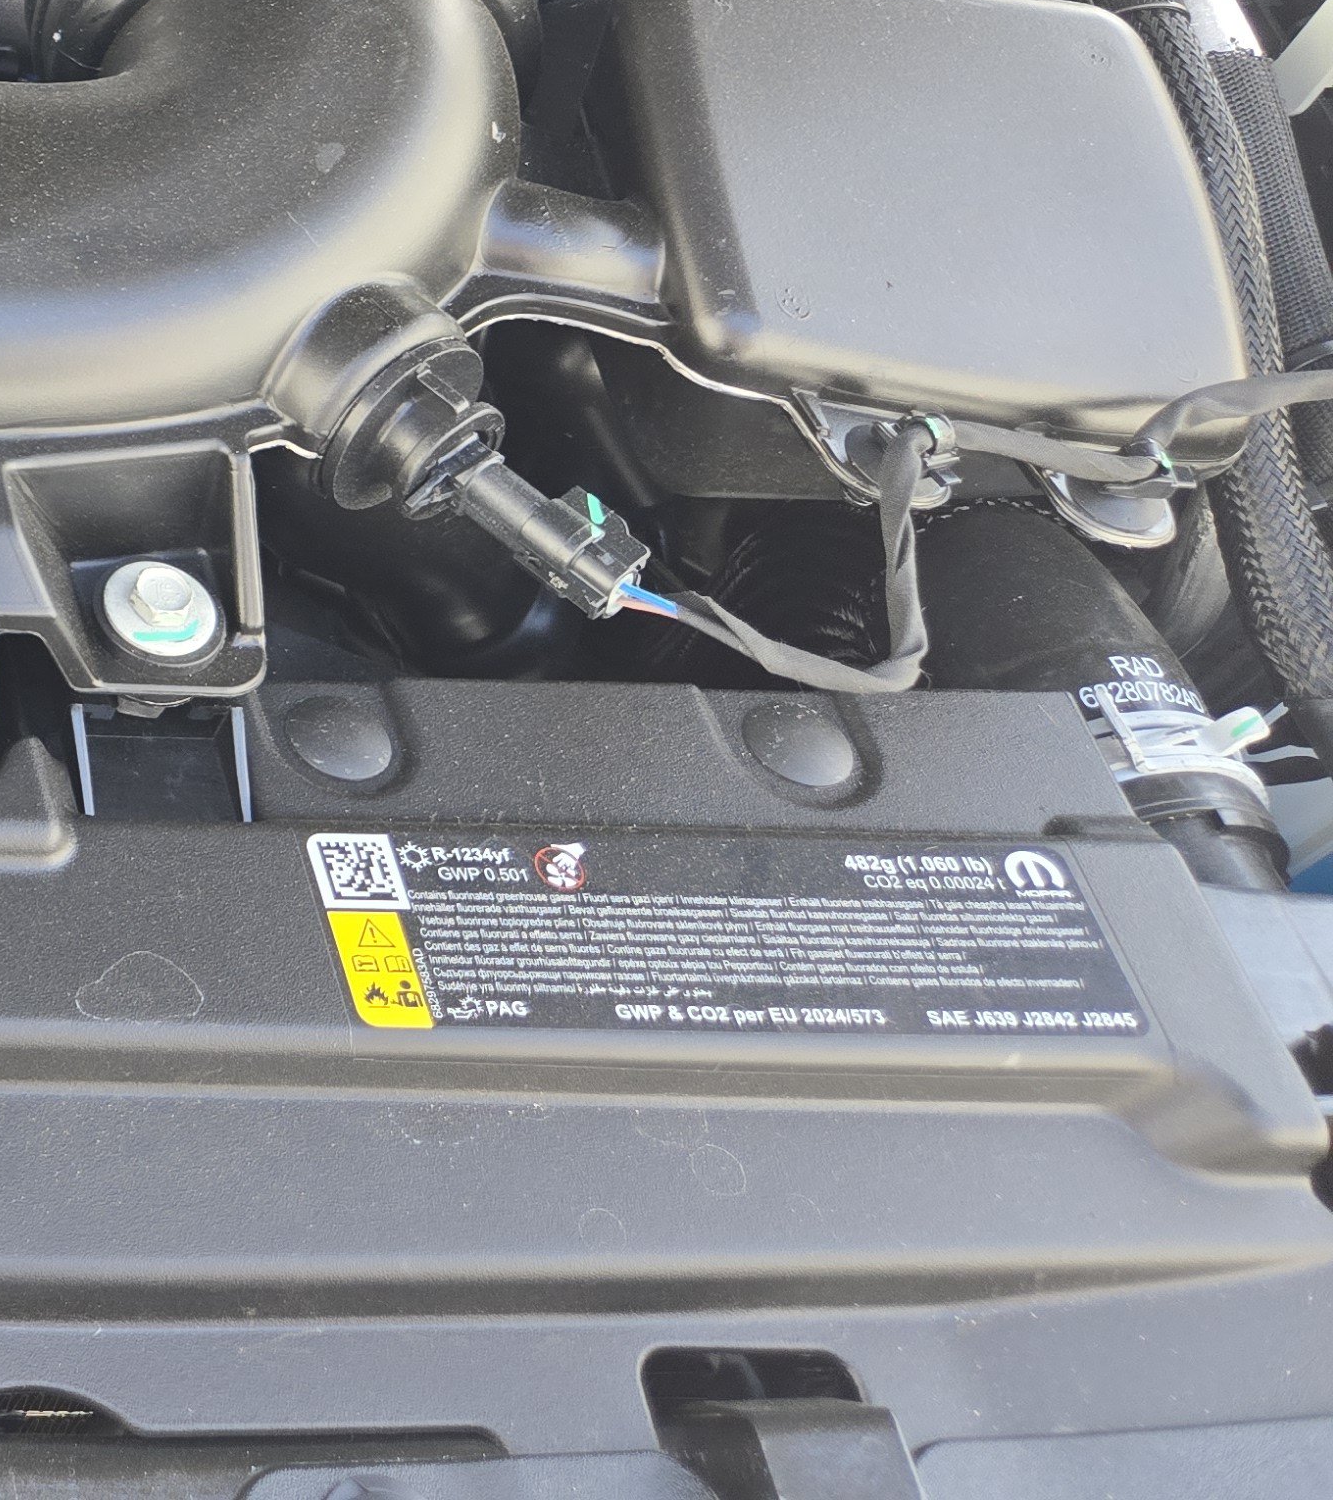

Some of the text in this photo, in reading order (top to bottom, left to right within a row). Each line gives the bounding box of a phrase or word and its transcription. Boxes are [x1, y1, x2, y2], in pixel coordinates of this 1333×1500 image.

[1108, 656, 1164, 678] RAD
[432, 847, 510, 865] R-1234yf
[844, 854, 993, 875] 482g (1.060 lb)
[438, 867, 528, 882] GWP 0.501
[864, 875, 902, 889] CO2
[905, 878, 929, 891] eq
[932, 876, 995, 891] 0.00024
[408, 890, 447, 900] Contains
[447, 891, 494, 901] fluorinated
[494, 892, 549, 904] greenhouse
[548, 895, 577, 904] gases
[1016, 889, 1071, 898] MOPAR
[461, 931, 479, 940] gas
[424, 943, 463, 952] Contient
[463, 943, 481, 952] des
[482, 945, 500, 954] gaz
[485, 1000, 528, 1017] PAG
[615, 1004, 886, 1027] GWP & CO2 per EU 2024/573
[926, 1010, 1138, 1029] SAE J639 J2842 J2845
